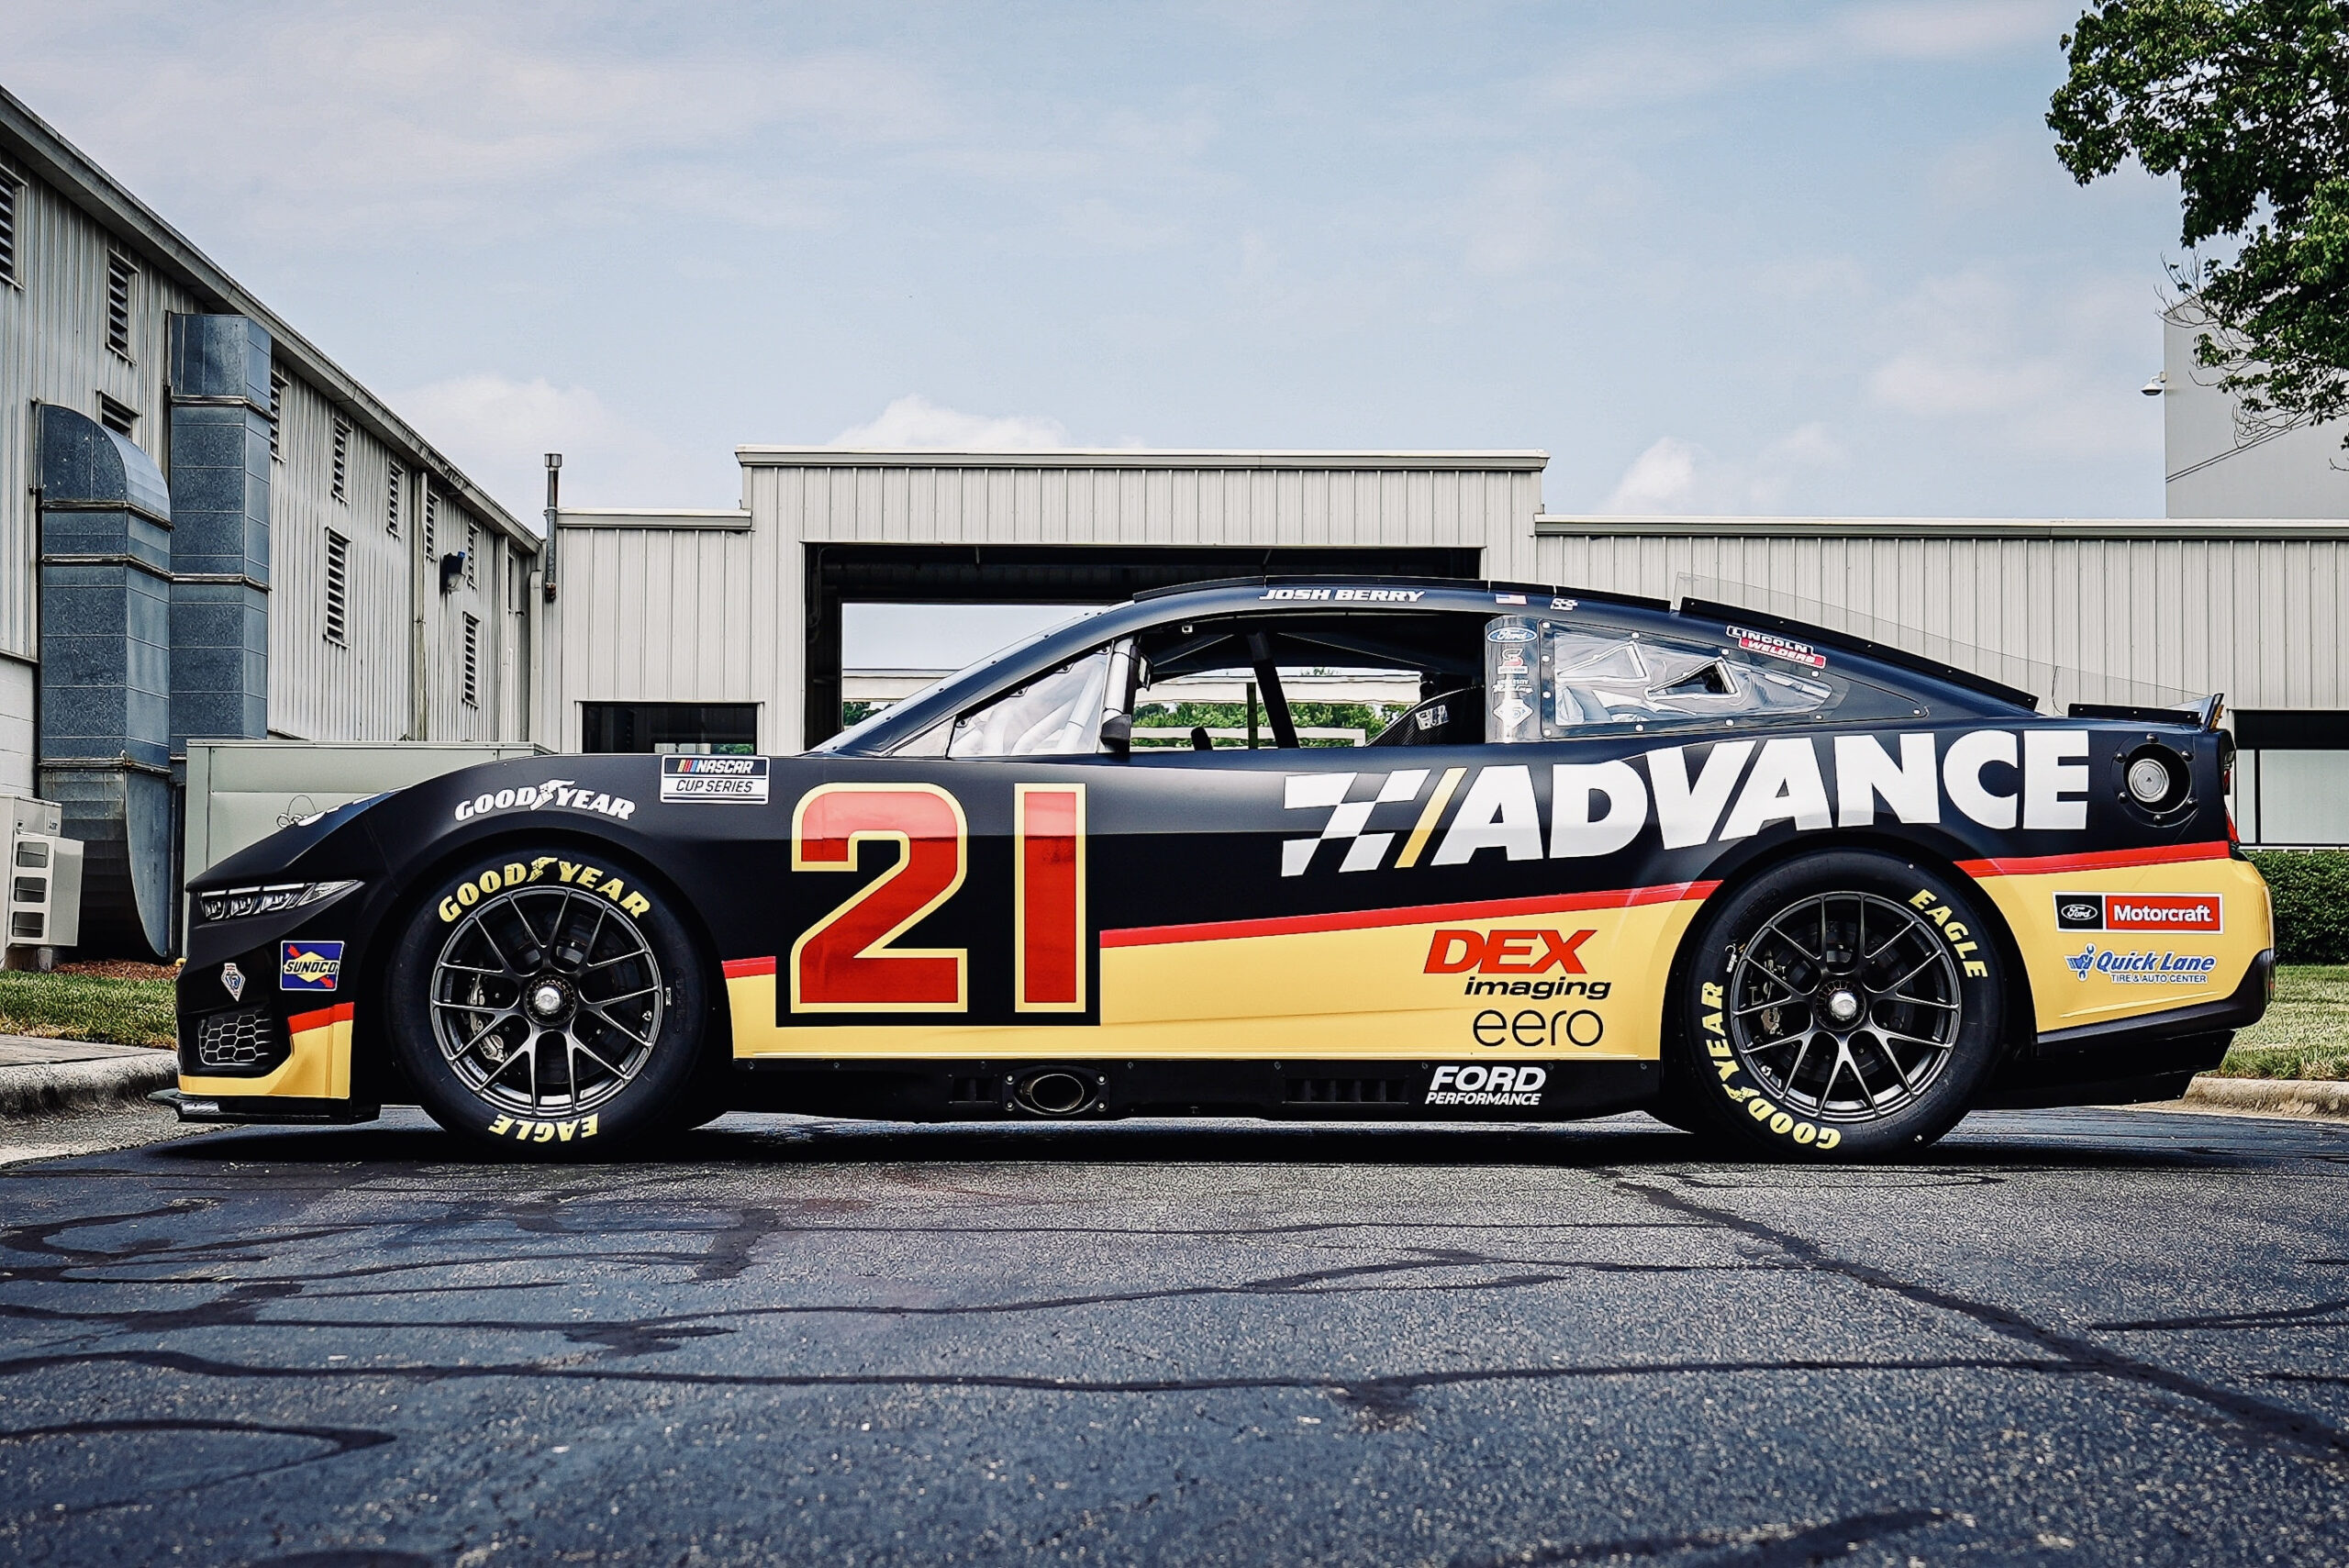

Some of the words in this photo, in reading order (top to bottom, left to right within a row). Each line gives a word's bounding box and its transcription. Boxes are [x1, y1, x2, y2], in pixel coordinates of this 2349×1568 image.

[1259, 589, 1331, 601] JOSH
[1334, 590, 1426, 603] BERRY
[1732, 628, 1808, 653] LINCOLN
[1747, 640, 1816, 663] WELDERS
[696, 760, 754, 773] NASCAR
[676, 779, 704, 792] CUP
[705, 780, 754, 793] SERIES
[1431, 729, 2089, 865] ADVANCE
[791, 782, 1086, 1013] 21
[2065, 905, 2094, 919] Ford
[2113, 905, 2212, 922] Motorcraft
[1909, 889, 1988, 978] EAGLE
[1423, 929, 1598, 973] DEX
[2096, 951, 2158, 973] Quick
[2160, 952, 2216, 972] Lane
[285, 961, 340, 973] SUNOCO
[2111, 974, 2132, 983] TIRE
[2133, 974, 2140, 983] &
[2142, 974, 2167, 983] AUTO
[2169, 974, 2207, 983] CENTER
[1464, 976, 1611, 1000] imaging
[1473, 1009, 1604, 1047] eero
[1430, 1065, 1546, 1092] FORD
[1425, 1092, 1542, 1106] PERFORMANCE
[488, 1113, 600, 1142] EAGLE
